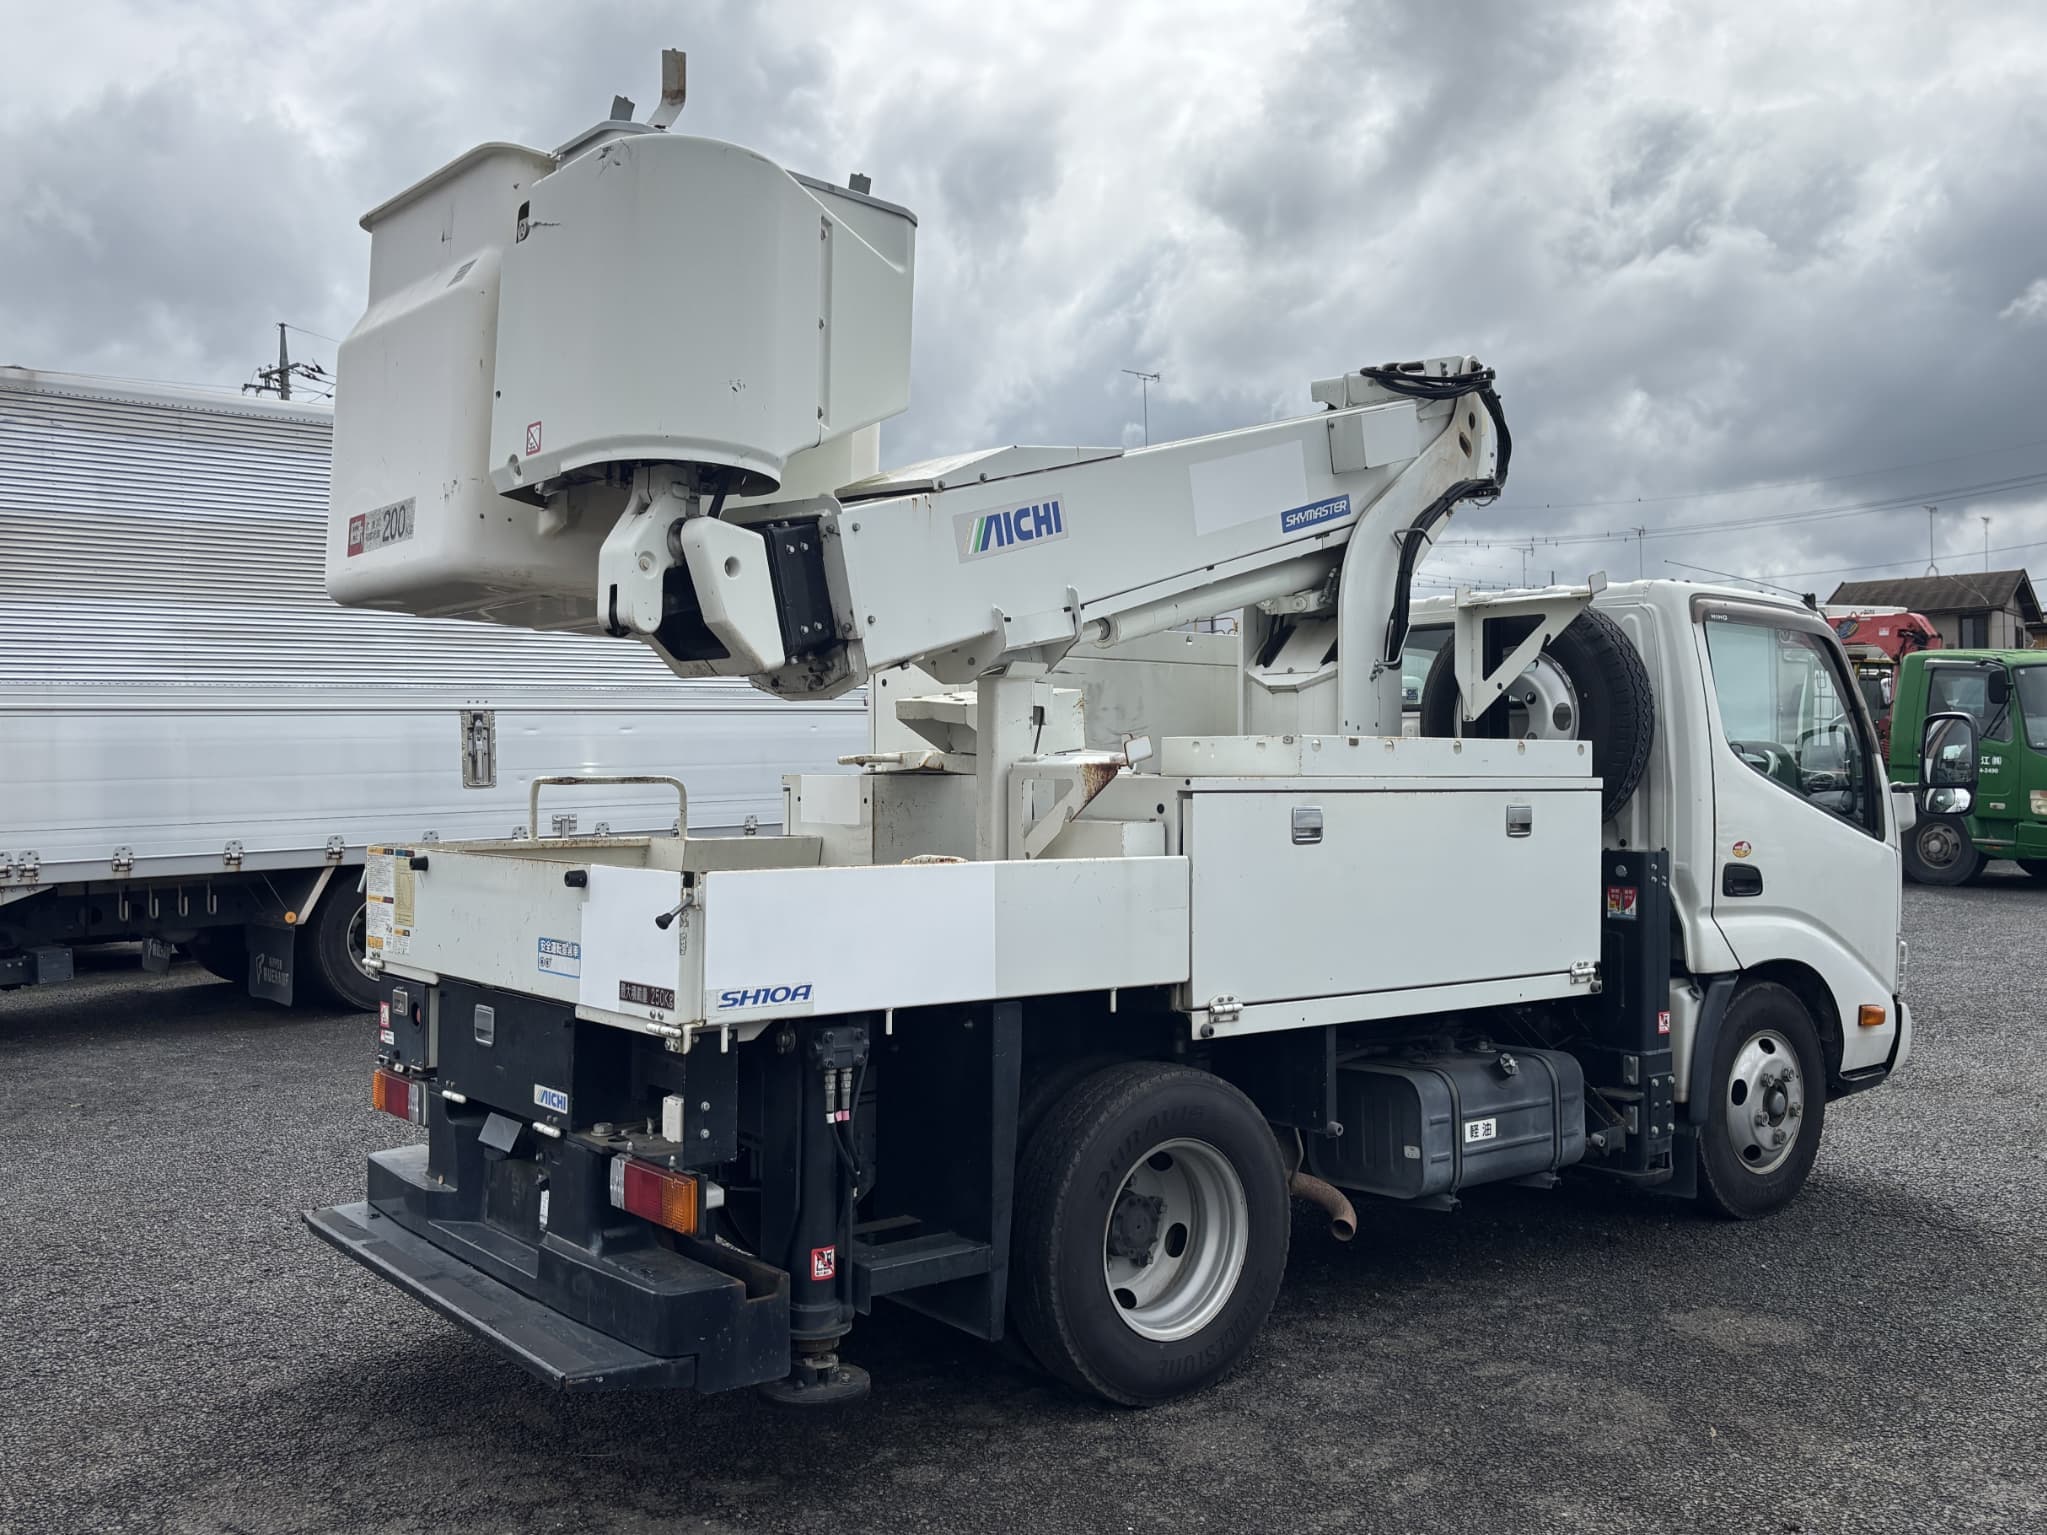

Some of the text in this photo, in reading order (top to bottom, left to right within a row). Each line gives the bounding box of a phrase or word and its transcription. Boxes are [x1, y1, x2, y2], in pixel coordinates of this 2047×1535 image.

[979, 500, 1063, 553] AICHI
[1285, 500, 1347, 528] SKYMASTER
[719, 984, 812, 1009] SH10A
[541, 1089, 567, 1111] AICHI
[1470, 1121, 1492, 1139] 軽油
